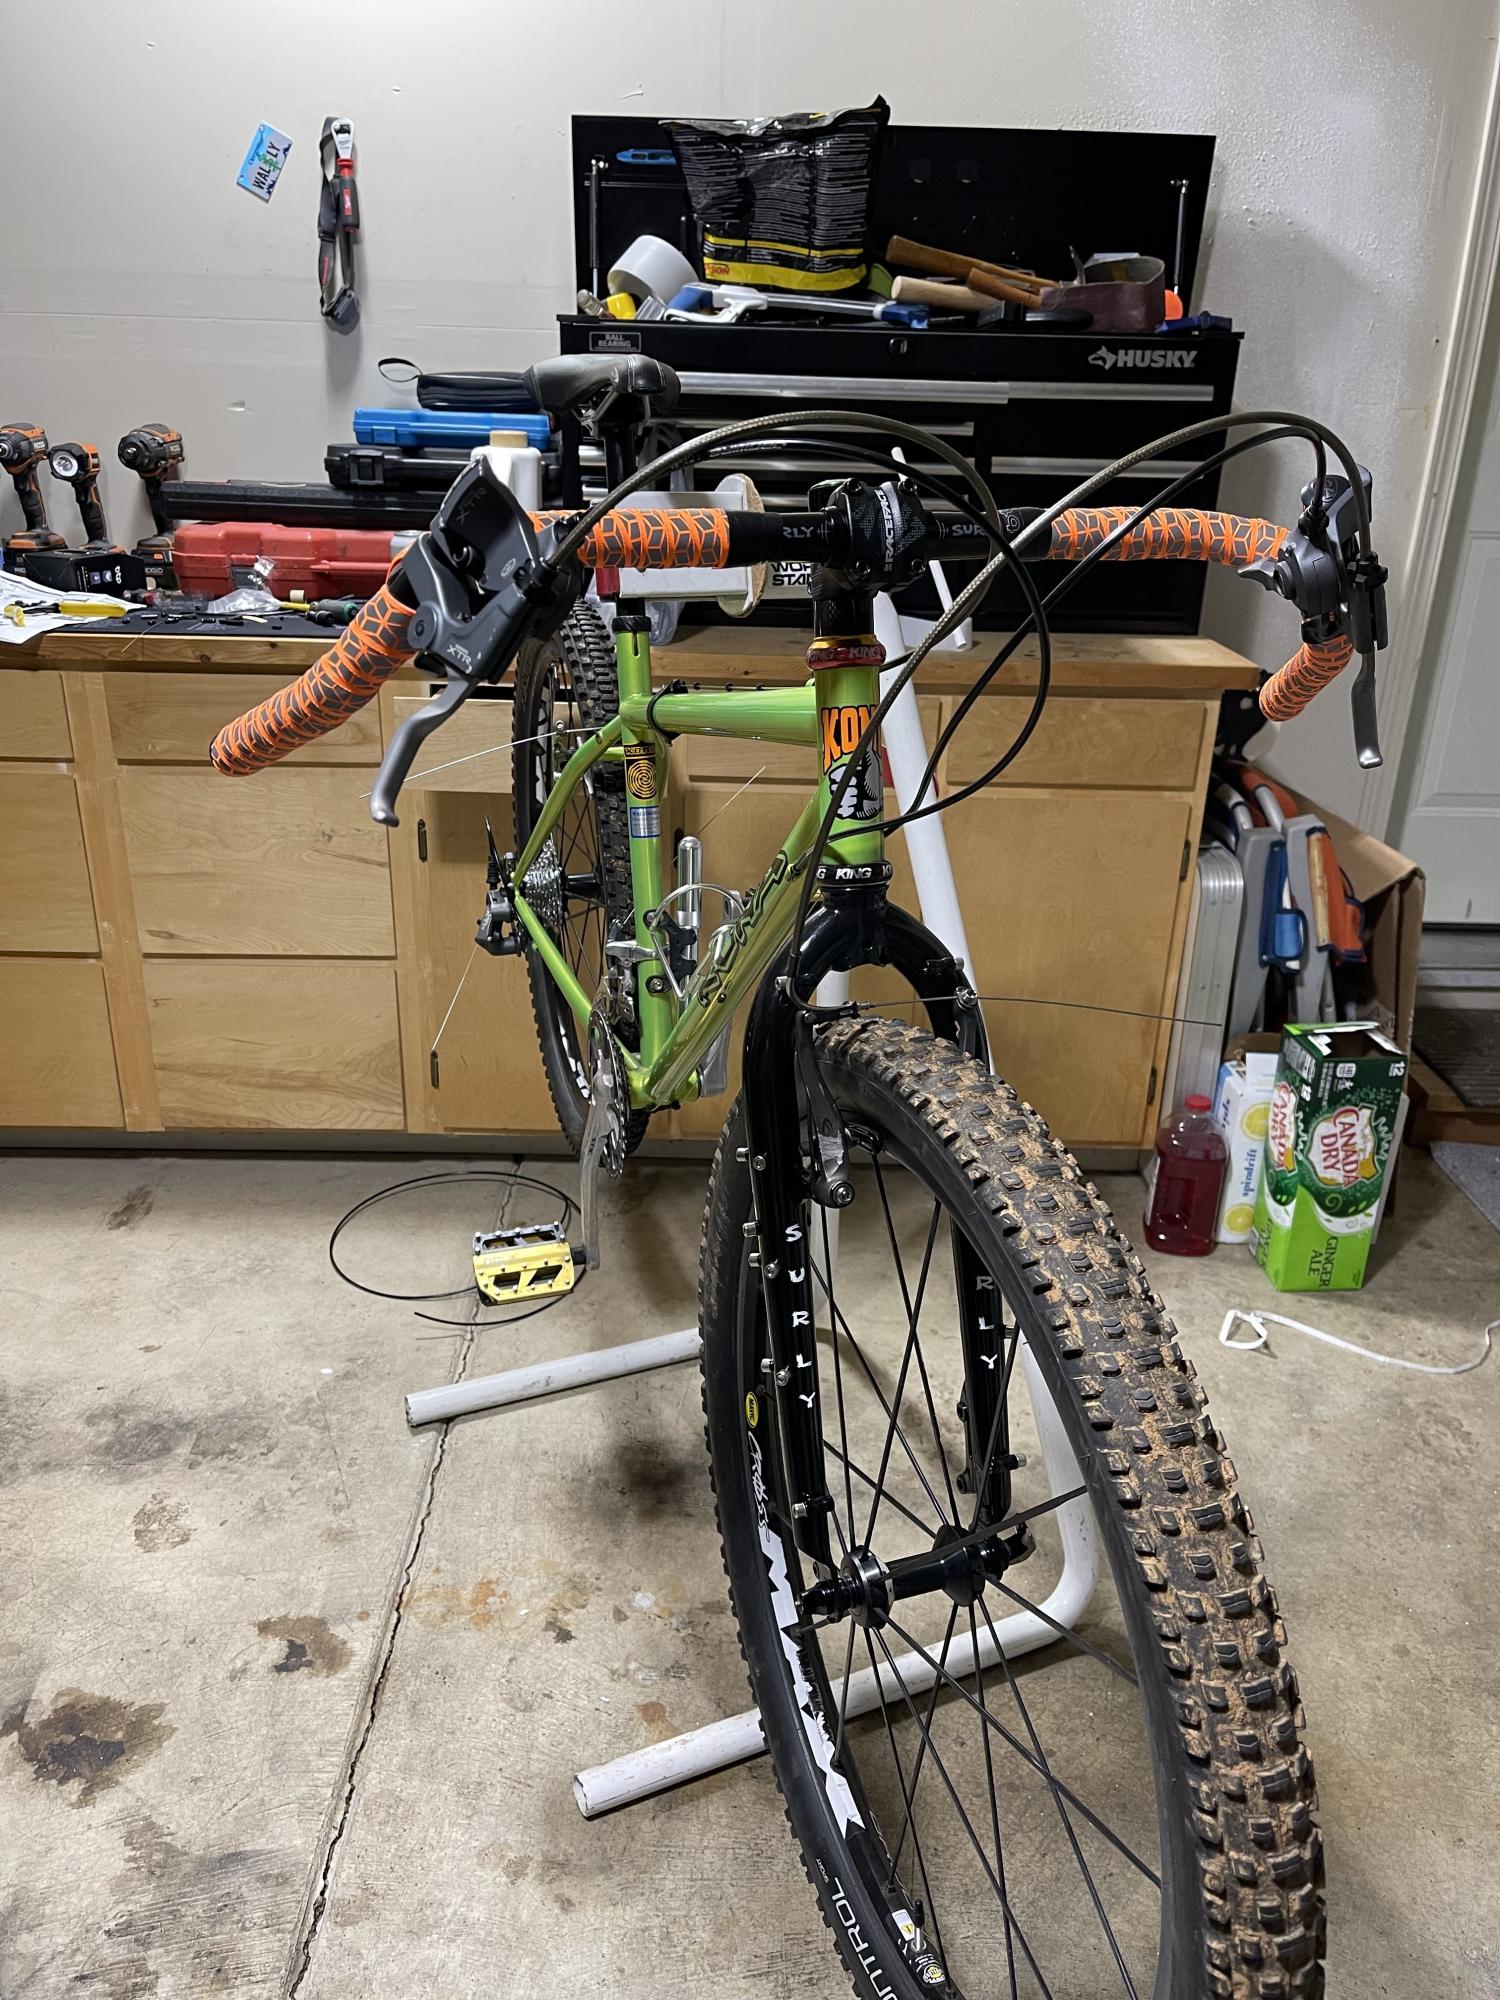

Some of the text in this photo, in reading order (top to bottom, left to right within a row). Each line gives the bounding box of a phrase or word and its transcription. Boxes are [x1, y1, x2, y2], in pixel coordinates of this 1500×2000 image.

[1116, 349, 1197, 368] HUSKY
[782, 526, 814, 538] RLY
[951, 524, 987, 537] SUR
[448, 645, 472, 665] XTR
[821, 705, 880, 773] KON
[835, 867, 873, 880] KING
[1320, 1133, 1342, 1173] DRY
[1332, 1105, 1361, 1188] CANADA
[1242, 1149, 1257, 1197] spindrift
[1307, 1249, 1322, 1277] ALE
[1318, 1236, 1339, 1288] GINGER
[785, 1223, 815, 1408] SURLY
[976, 1275, 998, 1370] RLY
[815, 1858, 829, 1884] SPORT
